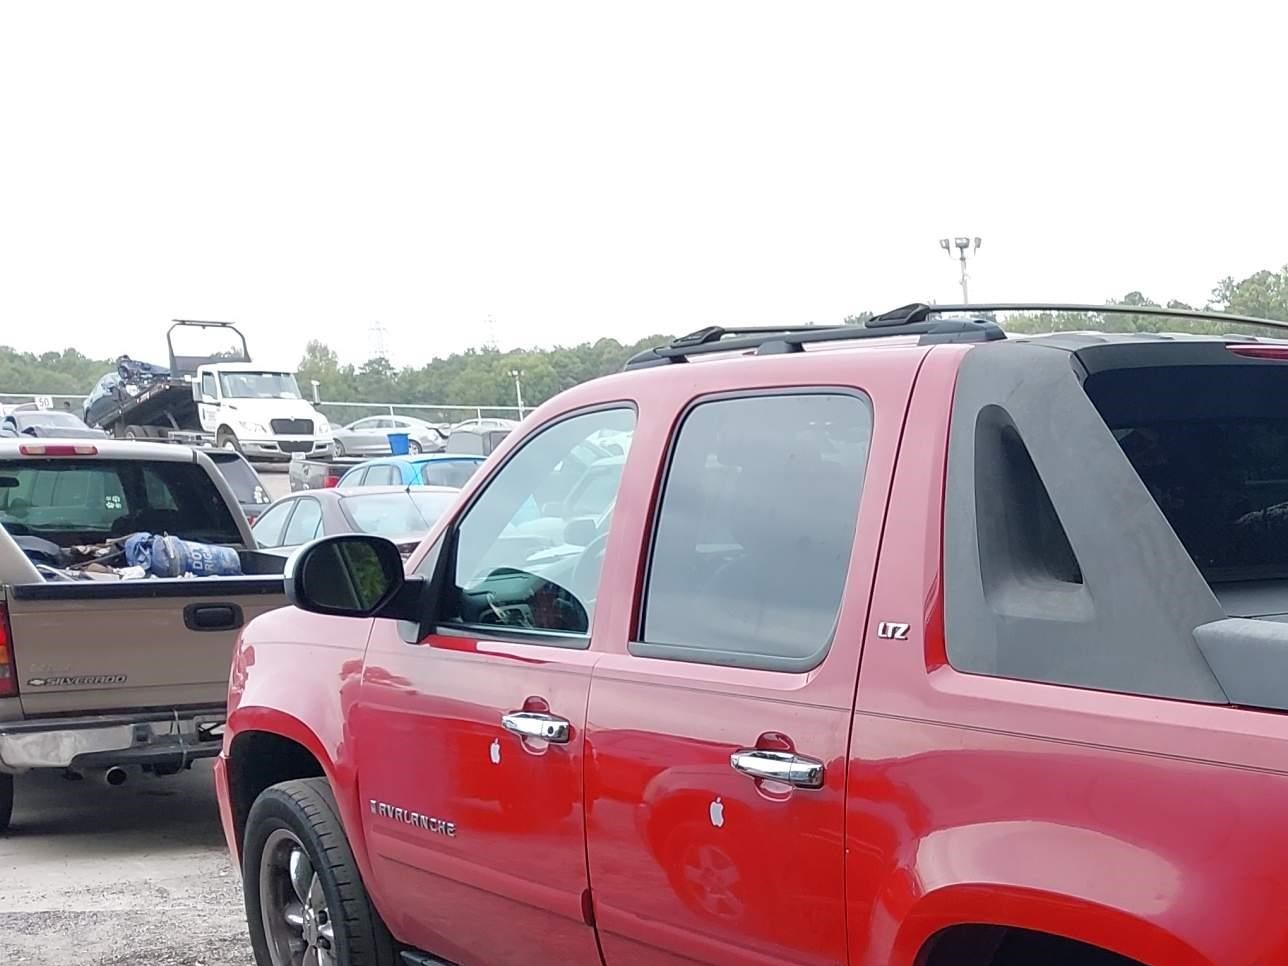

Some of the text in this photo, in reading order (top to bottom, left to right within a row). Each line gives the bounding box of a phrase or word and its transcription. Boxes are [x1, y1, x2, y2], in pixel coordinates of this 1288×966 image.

[878, 621, 910, 640] LTZ
[47, 674, 127, 686] SILVERADO
[378, 802, 456, 837] AVALANCHE
